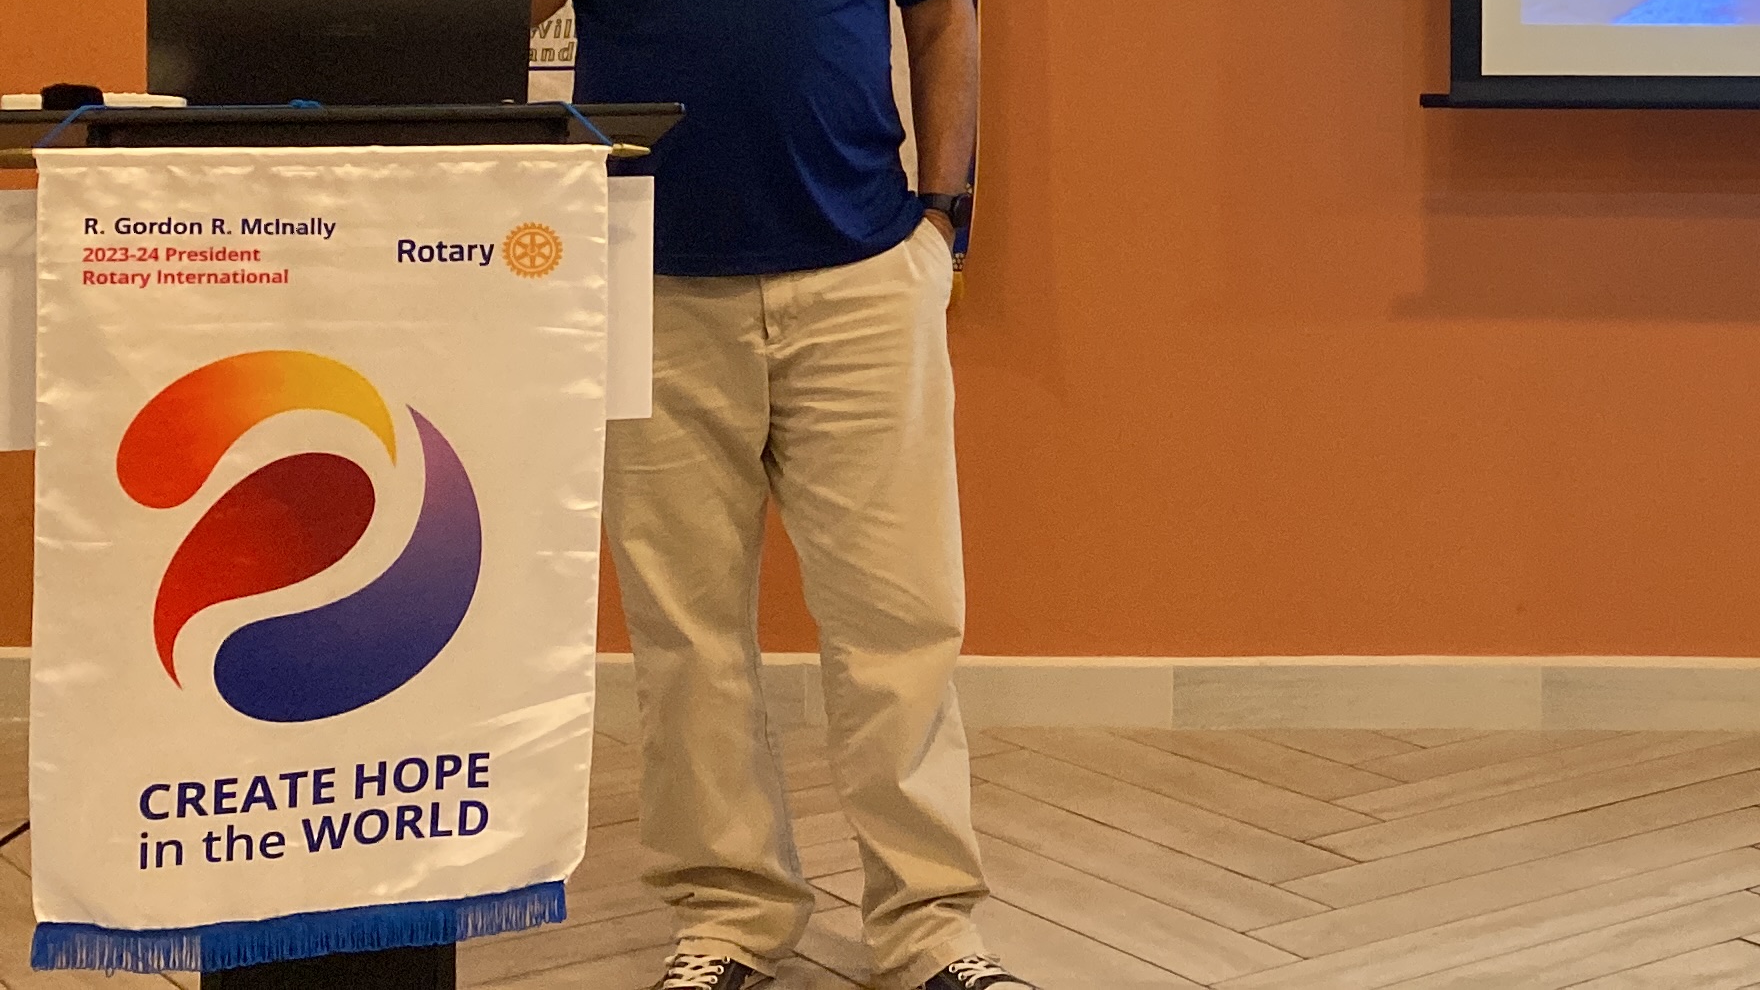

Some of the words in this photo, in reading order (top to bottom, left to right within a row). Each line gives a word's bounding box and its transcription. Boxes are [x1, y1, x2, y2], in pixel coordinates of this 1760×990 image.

[84, 217, 105, 236] R.
[114, 216, 203, 236] Gordon
[211, 217, 233, 236] R.
[240, 216, 337, 240] McInally
[82, 246, 160, 263] 2023-24
[165, 246, 261, 263] President
[396, 239, 496, 266] Rotary
[82, 268, 152, 289] Rotary
[157, 267, 289, 286] International
[138, 767, 337, 821] CREATE
[354, 751, 490, 800] HOPE
[138, 833, 184, 870] in
[202, 825, 286, 864] the
[301, 799, 489, 851] WORLD
